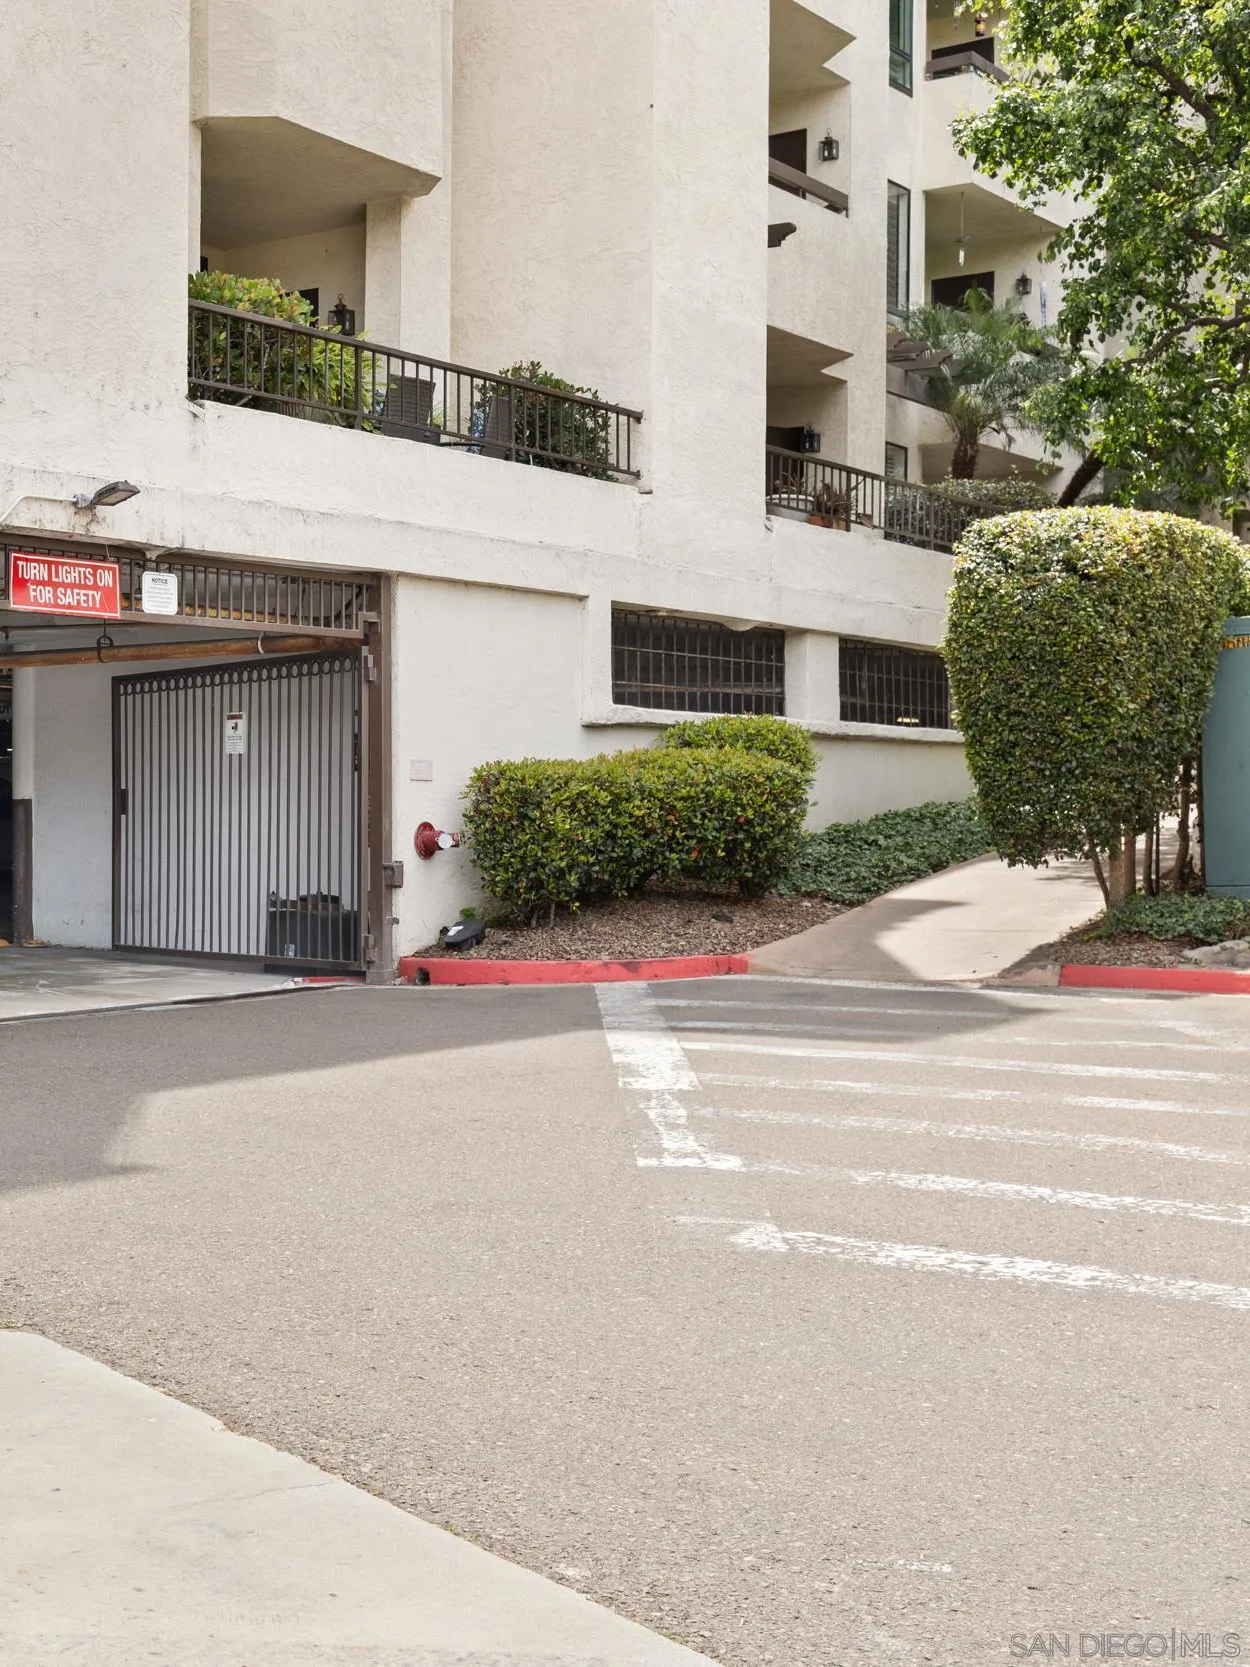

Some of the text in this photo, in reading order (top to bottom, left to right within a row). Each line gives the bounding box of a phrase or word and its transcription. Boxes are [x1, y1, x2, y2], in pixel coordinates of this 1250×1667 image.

[16, 560, 113, 588] TURN LIGHTS ON
[151, 577, 168, 585] NOTICE
[29, 584, 101, 608] FOR SAFETY
